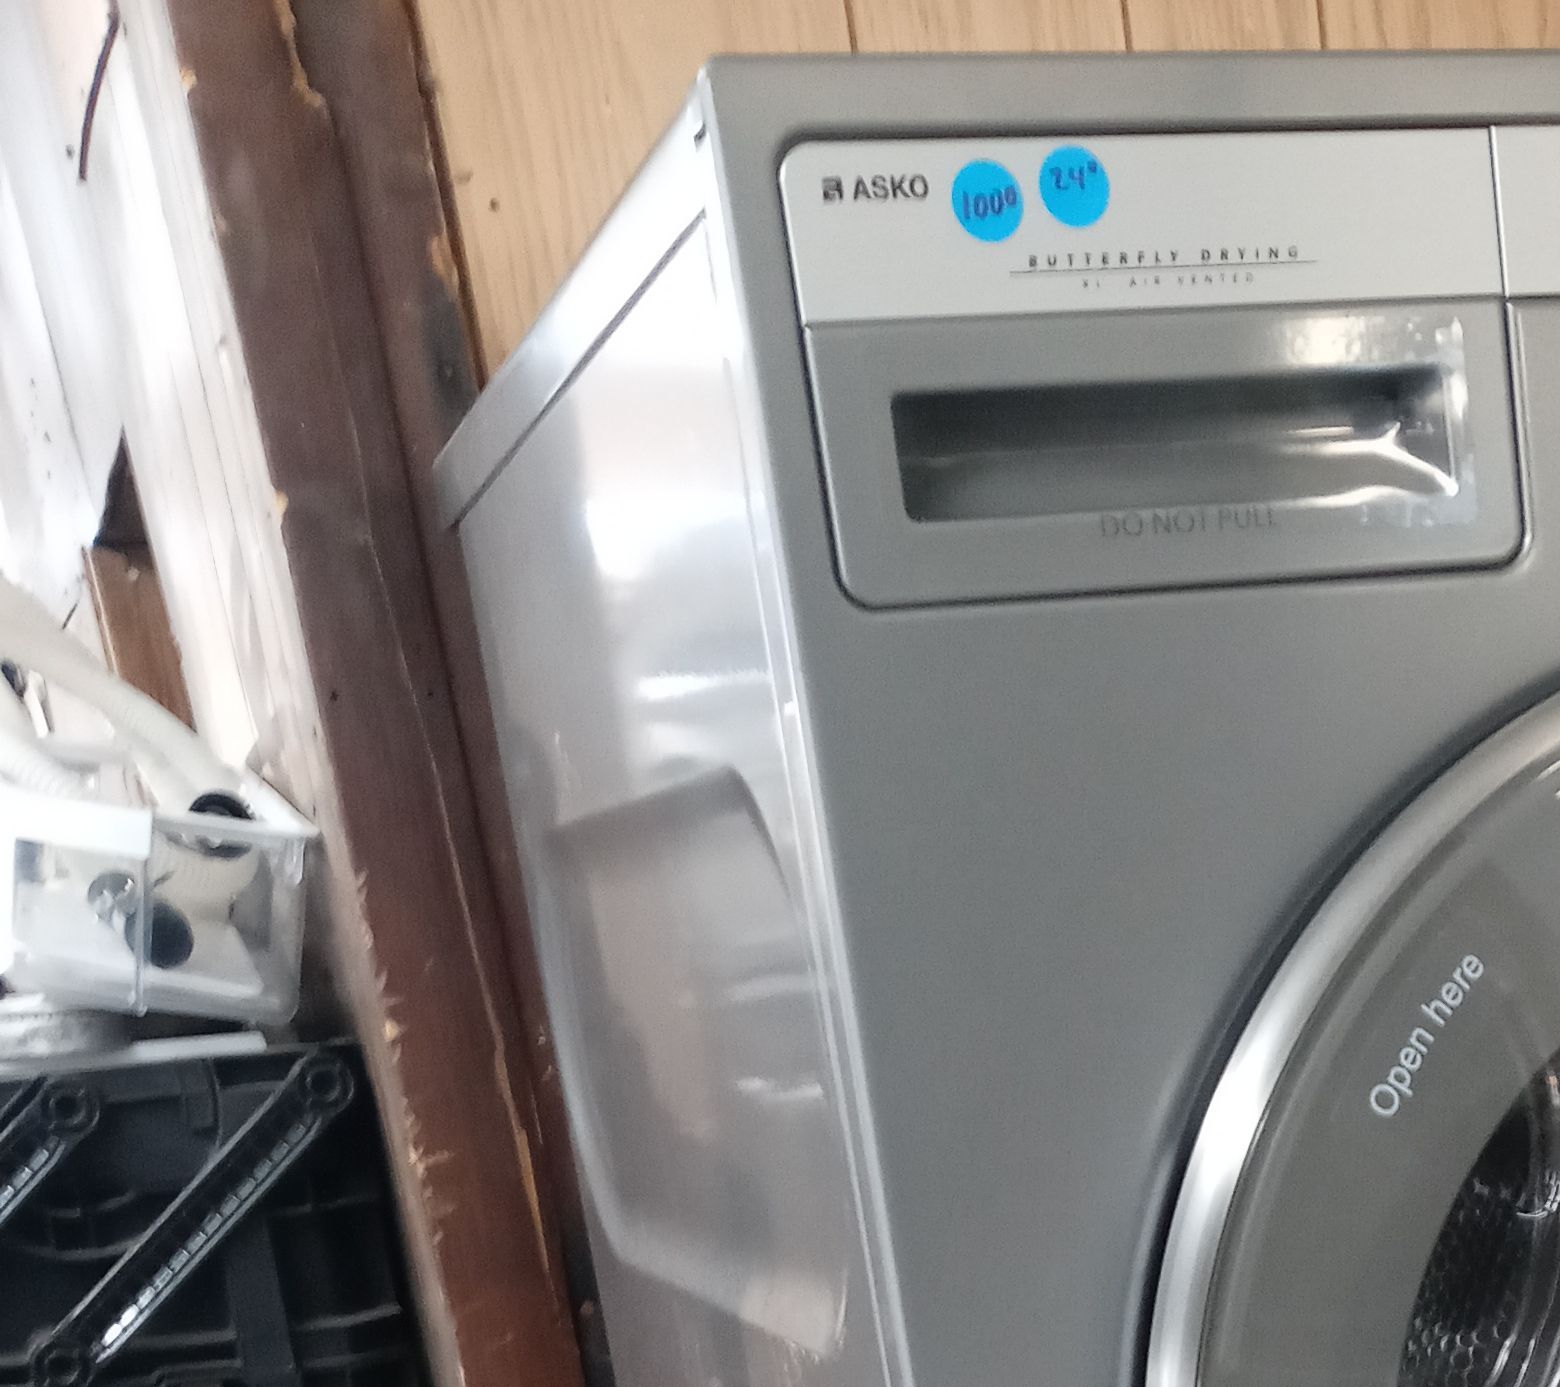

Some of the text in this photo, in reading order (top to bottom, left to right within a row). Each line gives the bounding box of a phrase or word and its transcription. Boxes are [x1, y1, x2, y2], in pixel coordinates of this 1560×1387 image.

[854, 174, 929, 200] ASKO
[1028, 246, 1299, 268] BUTTERFLY DRYING
[1101, 511, 1143, 537] DO
[1369, 953, 1485, 1118] Open here
